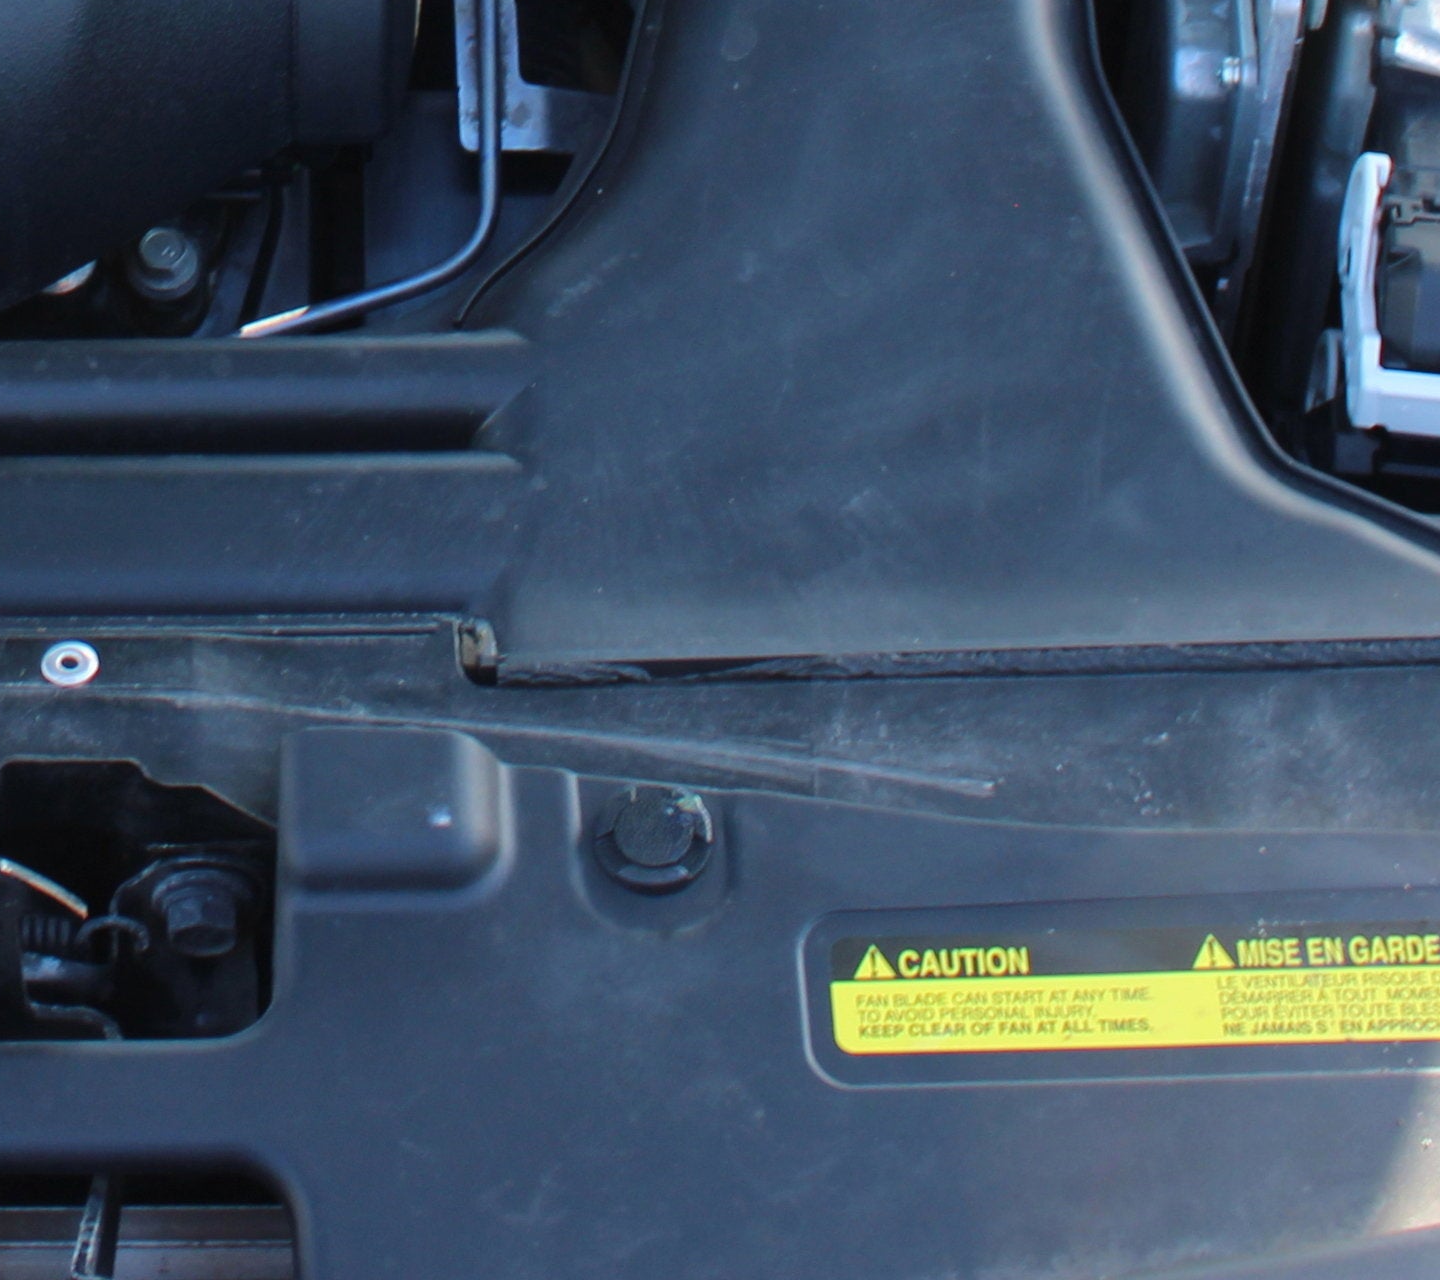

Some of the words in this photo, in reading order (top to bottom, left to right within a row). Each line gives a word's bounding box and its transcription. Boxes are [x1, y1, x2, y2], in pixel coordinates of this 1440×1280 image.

[1237, 938, 1302, 967] MISE
[1307, 937, 1344, 965] EN
[898, 946, 1030, 978] CAUTION
[1218, 975, 1238, 988] LE
[1243, 972, 1356, 988] VENTILATEUR
[1362, 971, 1424, 986] RISQUE
[856, 994, 889, 1008] FAN
[893, 993, 947, 1007] BLADE
[952, 991, 987, 1005] CAN
[992, 990, 1044, 1004] START
[1049, 989, 1069, 1002] AT
[1073, 988, 1106, 1001] ANY
[1334, 988, 1376, 1002] TOUT
[859, 1009, 881, 1023] TO
[884, 1008, 935, 1022] AVOID
[939, 1006, 1029, 1020] PERSONAL
[1222, 1006, 1268, 1020] POUR
[1338, 1003, 1398, 1017] TOUTE
[859, 1024, 905, 1038] KEEP
[908, 1022, 965, 1037] CLEAR
[971, 1022, 994, 1036] OF
[999, 1021, 1031, 1035] FAN
[1036, 1021, 1056, 1034] AT
[1061, 1019, 1092, 1033] ALL
[1098, 1018, 1153, 1033] TIMES.
[1223, 1022, 1245, 1036] NE
[1251, 1020, 1313, 1036] JAMAIS
